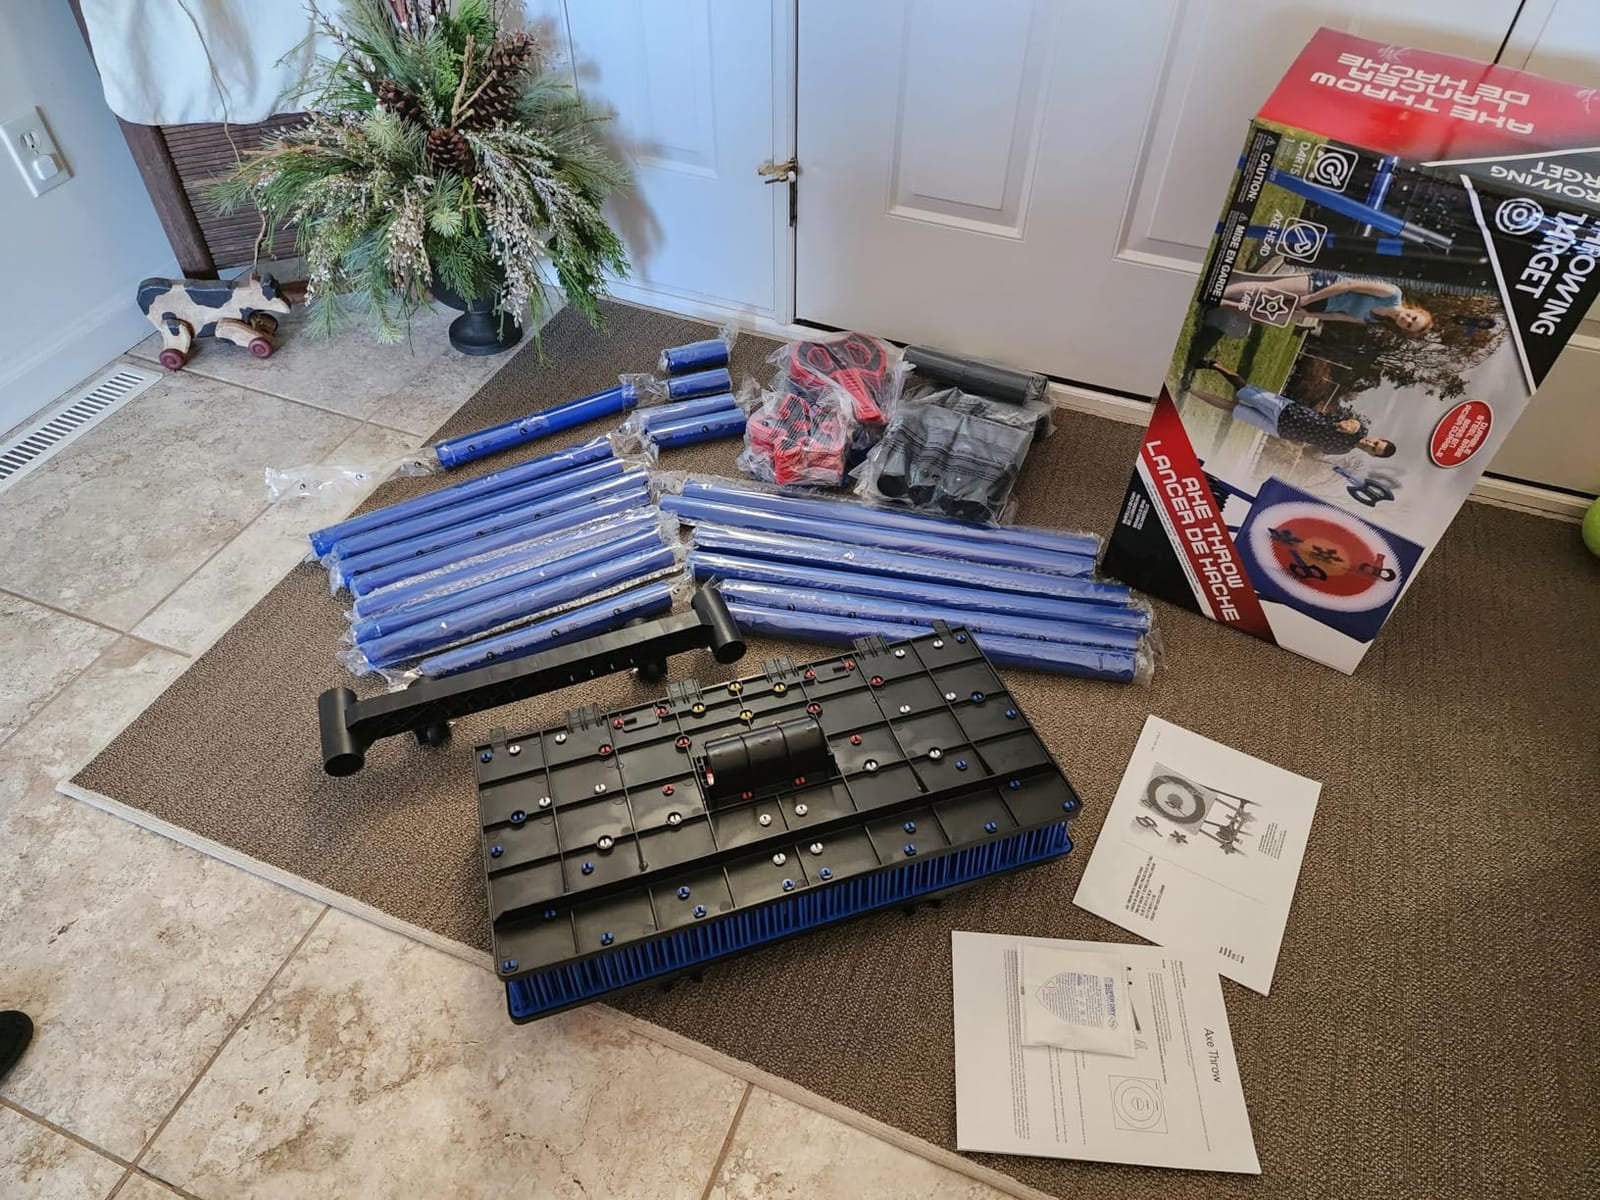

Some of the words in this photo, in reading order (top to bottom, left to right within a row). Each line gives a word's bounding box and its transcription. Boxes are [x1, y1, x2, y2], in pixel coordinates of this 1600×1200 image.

[1338, 52, 1467, 95] HACHE
[1348, 67, 1508, 113] LANCER
[1309, 71, 1439, 113] THROW
[1474, 83, 1530, 106] DE
[1450, 105, 1534, 135] AXE
[1290, 141, 1312, 177] DARTS
[1248, 152, 1271, 203] CAUTION:
[1229, 224, 1246, 249] MISE
[1268, 209, 1285, 232] AXE
[1225, 250, 1237, 265] EN
[1260, 230, 1278, 257] HEAD
[1515, 211, 1588, 300] TARGET
[1212, 265, 1231, 297] GARDE
[1435, 425, 1459, 458] DURABLE
[1464, 422, 1489, 455] DURABLE
[1465, 414, 1485, 438] STEEL
[1454, 439, 1470, 458] BASE
[1146, 440, 1196, 525] LANCER
[1184, 527, 1210, 555] DE
[1199, 558, 1241, 622] HACHE
[1182, 477, 1213, 520] AXE
[1204, 522, 1244, 589] THROW
[1204, 1028, 1215, 1048] Axe
[1208, 1050, 1221, 1084] Throw
